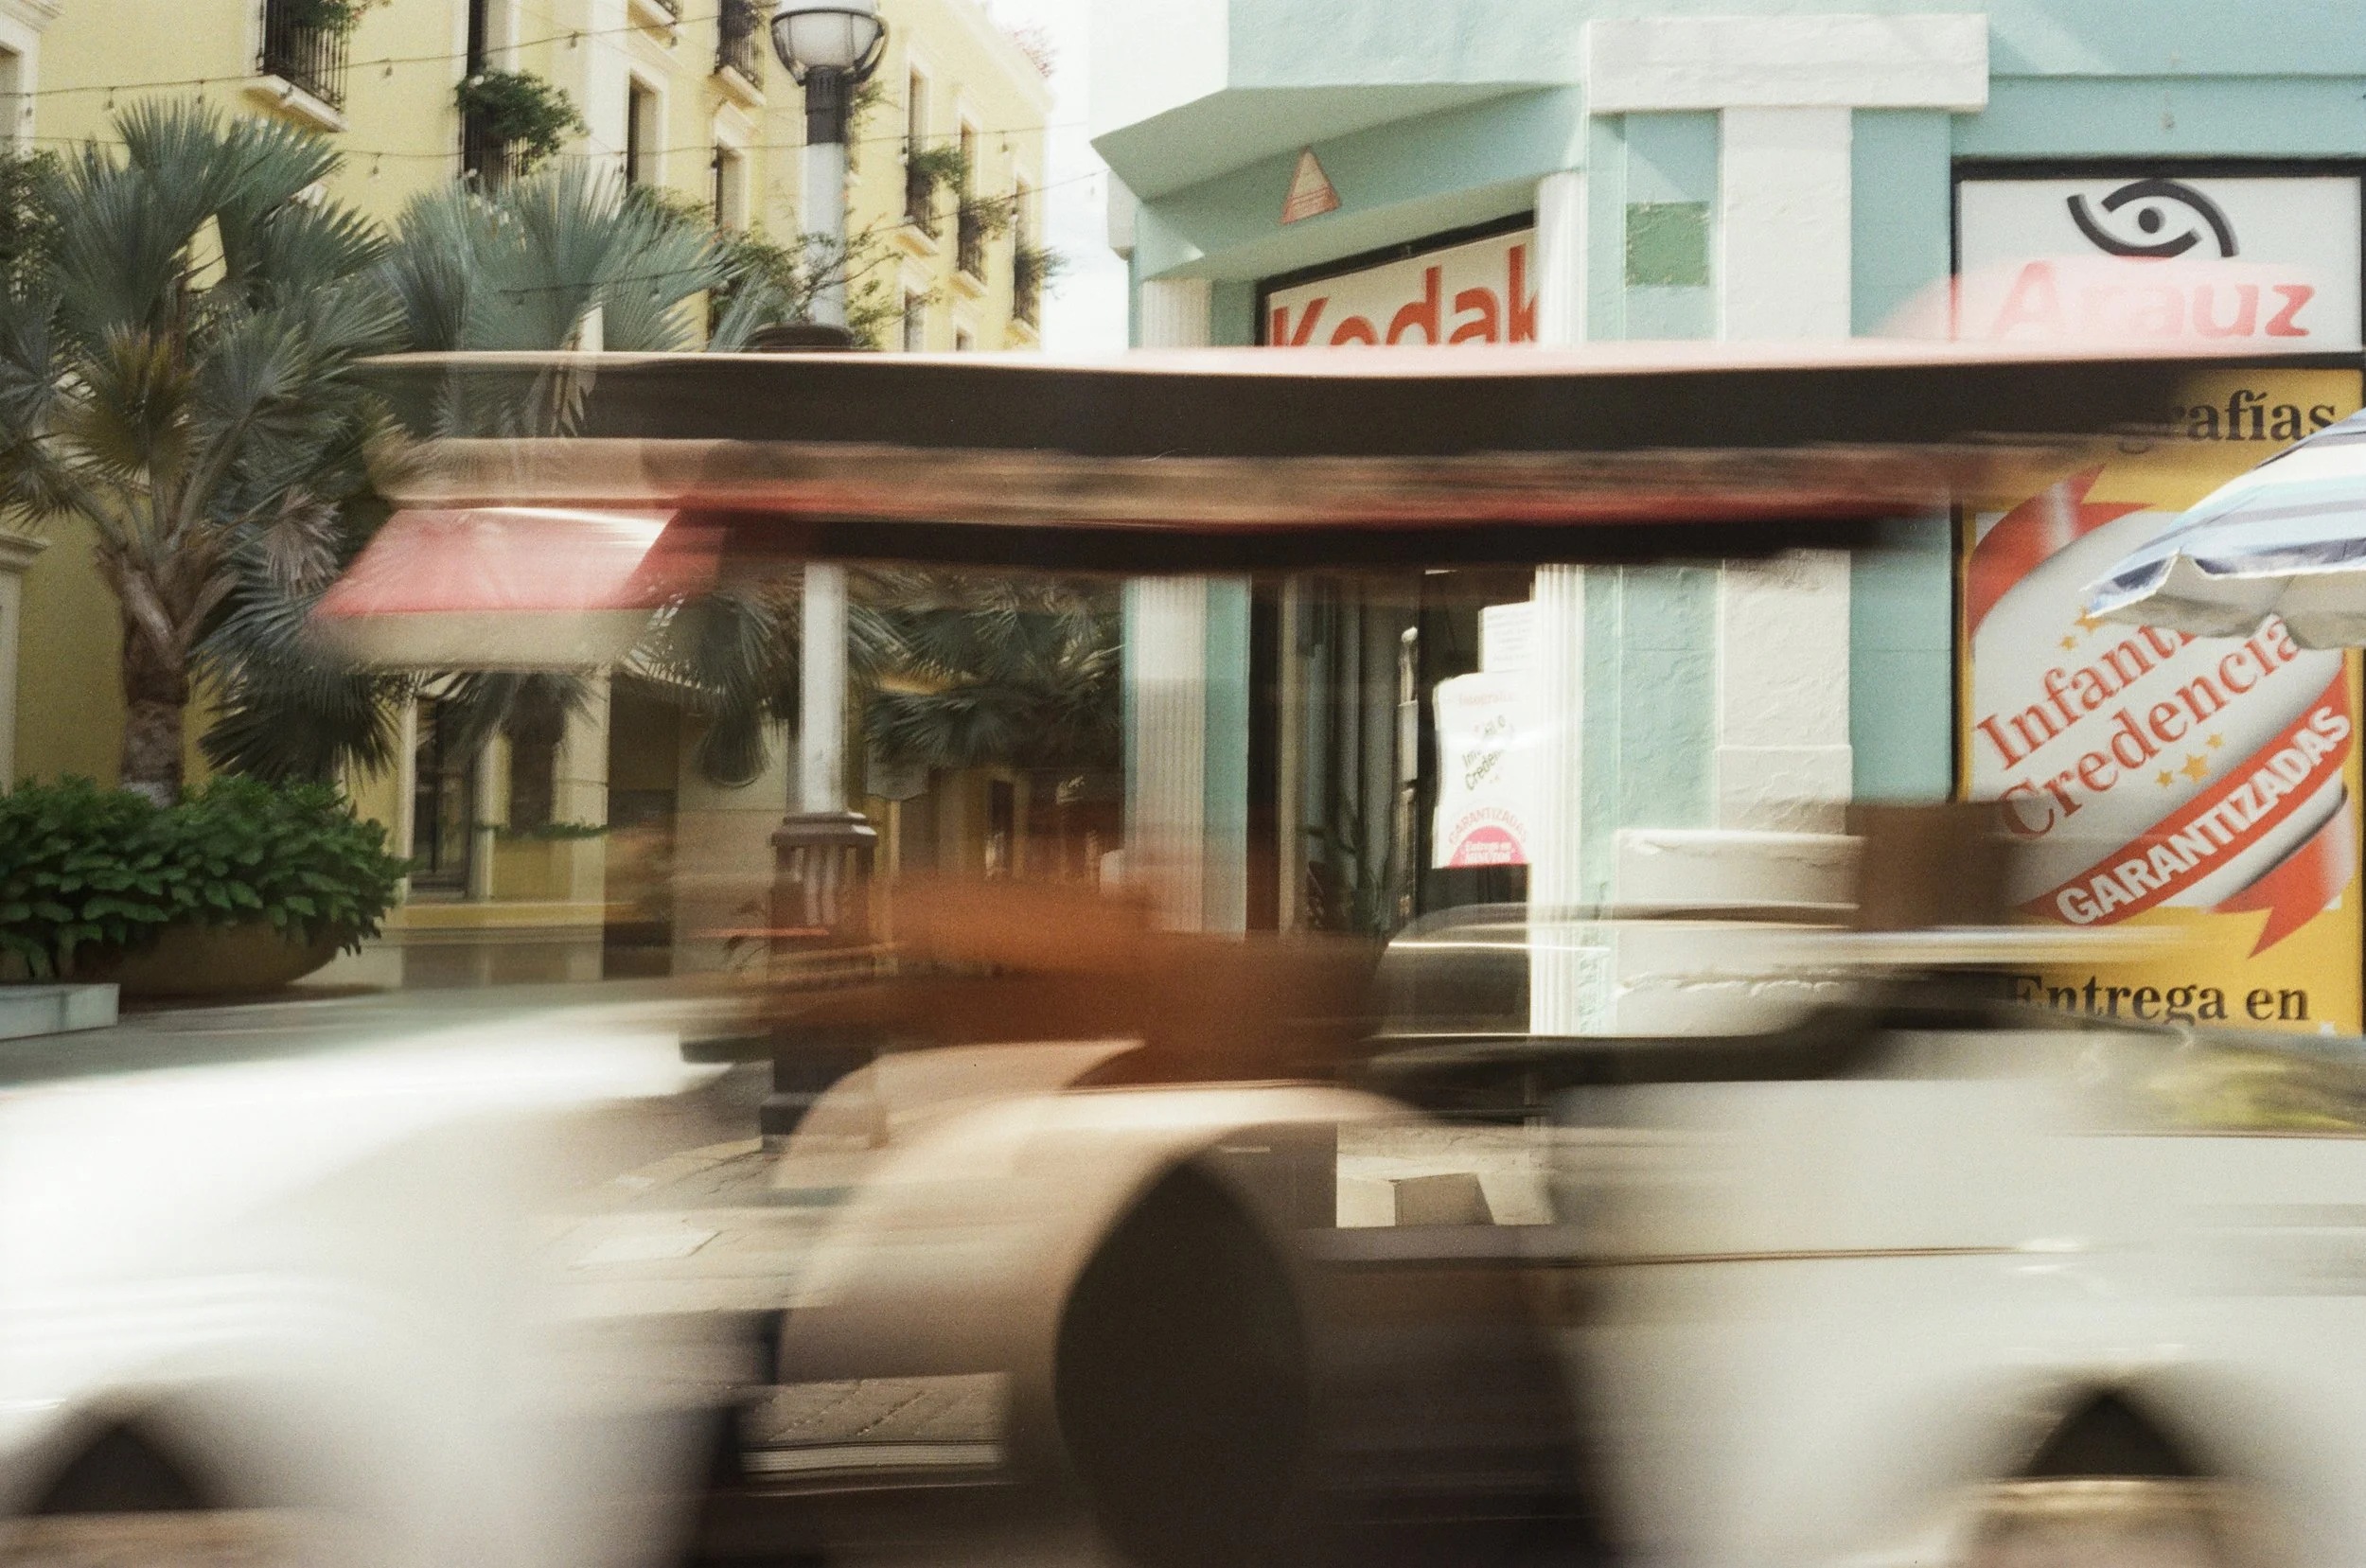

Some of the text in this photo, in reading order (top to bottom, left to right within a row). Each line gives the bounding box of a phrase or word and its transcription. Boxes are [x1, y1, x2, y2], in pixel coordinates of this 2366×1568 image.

[1990, 259, 2316, 339] Arauz
[2056, 706, 2351, 925] GARANTIZADAS
[2008, 974, 2310, 1028] Entrega en
